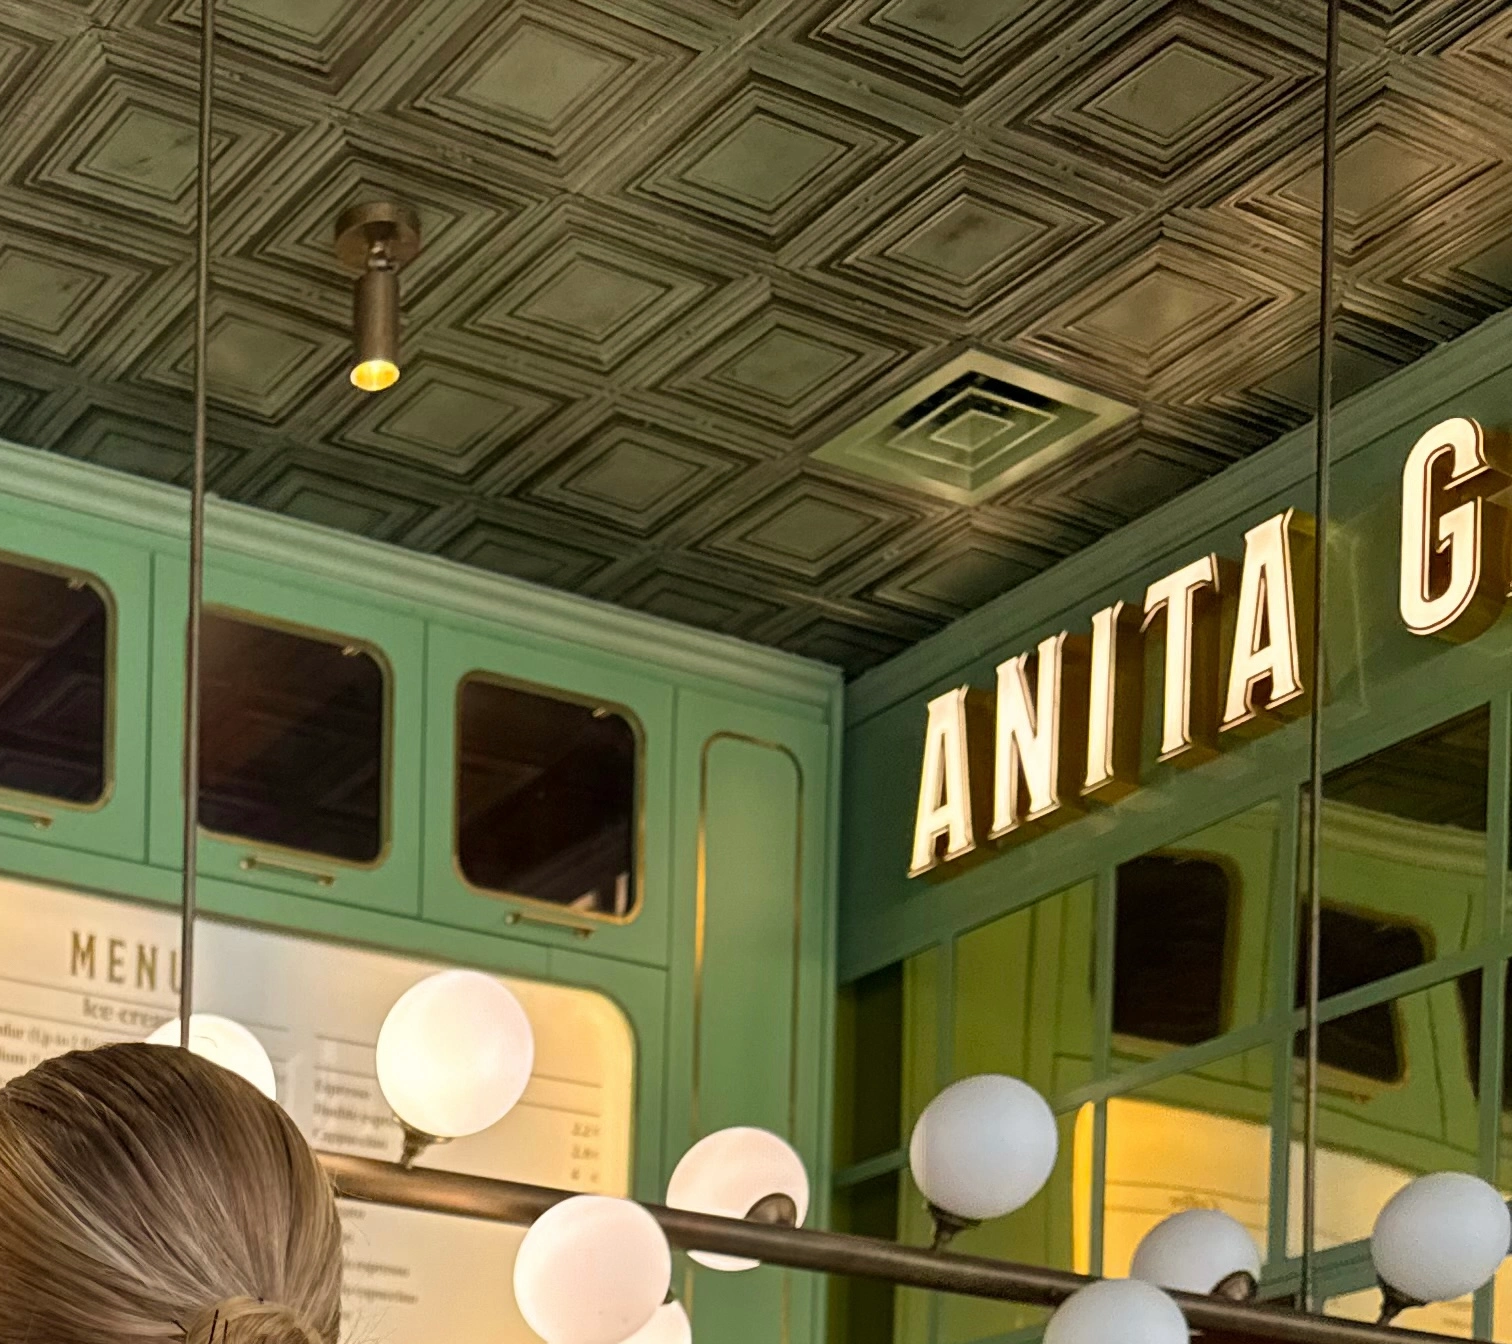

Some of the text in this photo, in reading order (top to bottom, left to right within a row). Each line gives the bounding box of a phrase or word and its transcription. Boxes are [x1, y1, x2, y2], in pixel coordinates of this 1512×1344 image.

[907, 416, 1512, 880] ANITA G
[70, 930, 182, 996] MENU
